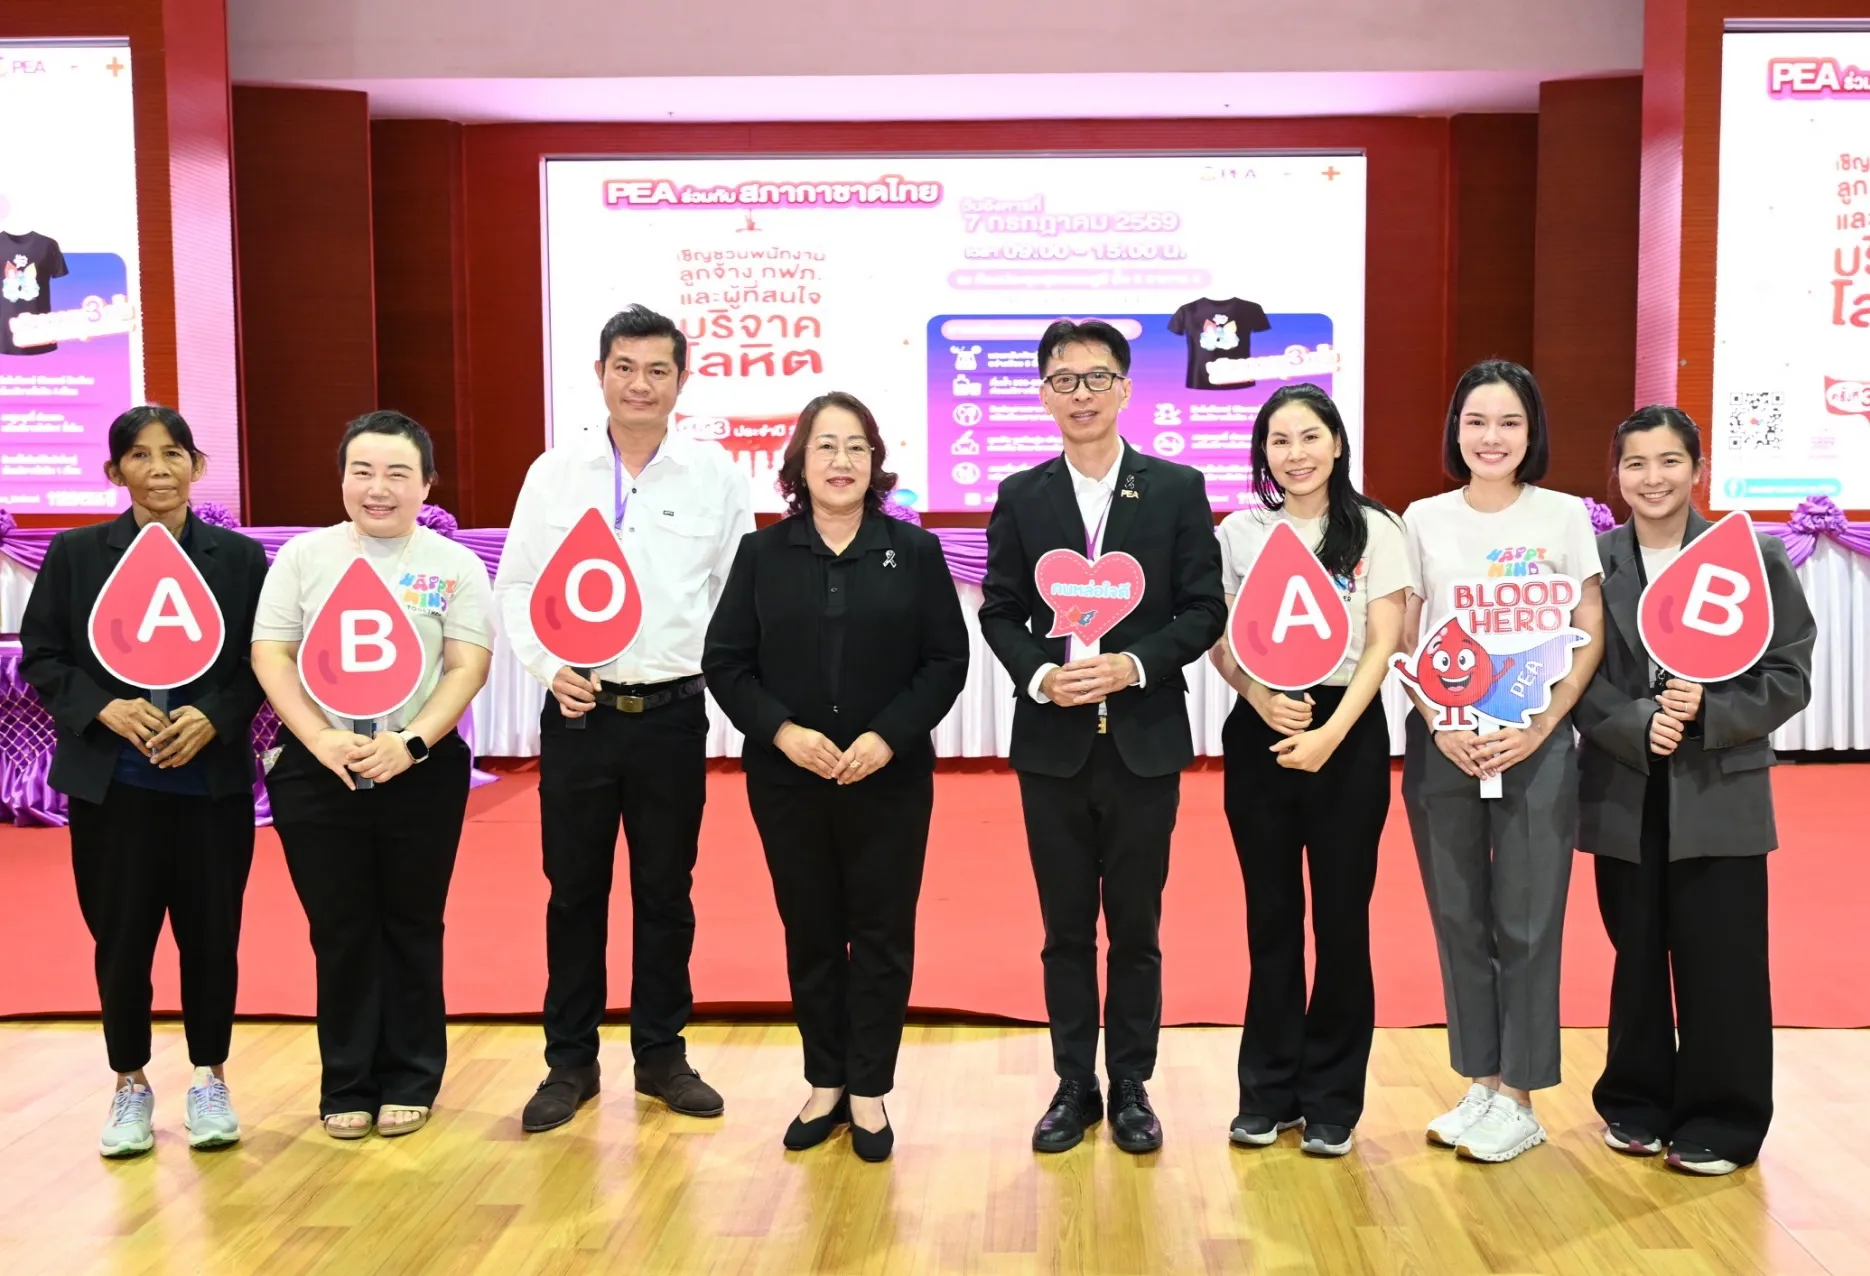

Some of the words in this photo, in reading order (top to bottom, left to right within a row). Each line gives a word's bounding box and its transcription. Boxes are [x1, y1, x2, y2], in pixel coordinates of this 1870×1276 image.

[1772, 62, 1840, 91] PEA
[608, 182, 677, 204] PEA
[739, 177, 939, 204] สภากาชาดไทย
[965, 214, 981, 232] 7
[1114, 212, 1180, 232] 2569
[680, 263, 752, 286] ลูกจ้าง
[680, 280, 822, 309] และผู้ที่สนใจ
[680, 309, 821, 339] บริจาค
[1121, 489, 1139, 499] PEA
[565, 558, 626, 622] O
[1454, 580, 1573, 609] BLOOD
[1682, 562, 1751, 636] B
[136, 576, 202, 643] A
[1271, 575, 1331, 644] A
[1469, 606, 1562, 634] HERO
[339, 609, 398, 673] B
[1509, 660, 1544, 699] PEA
